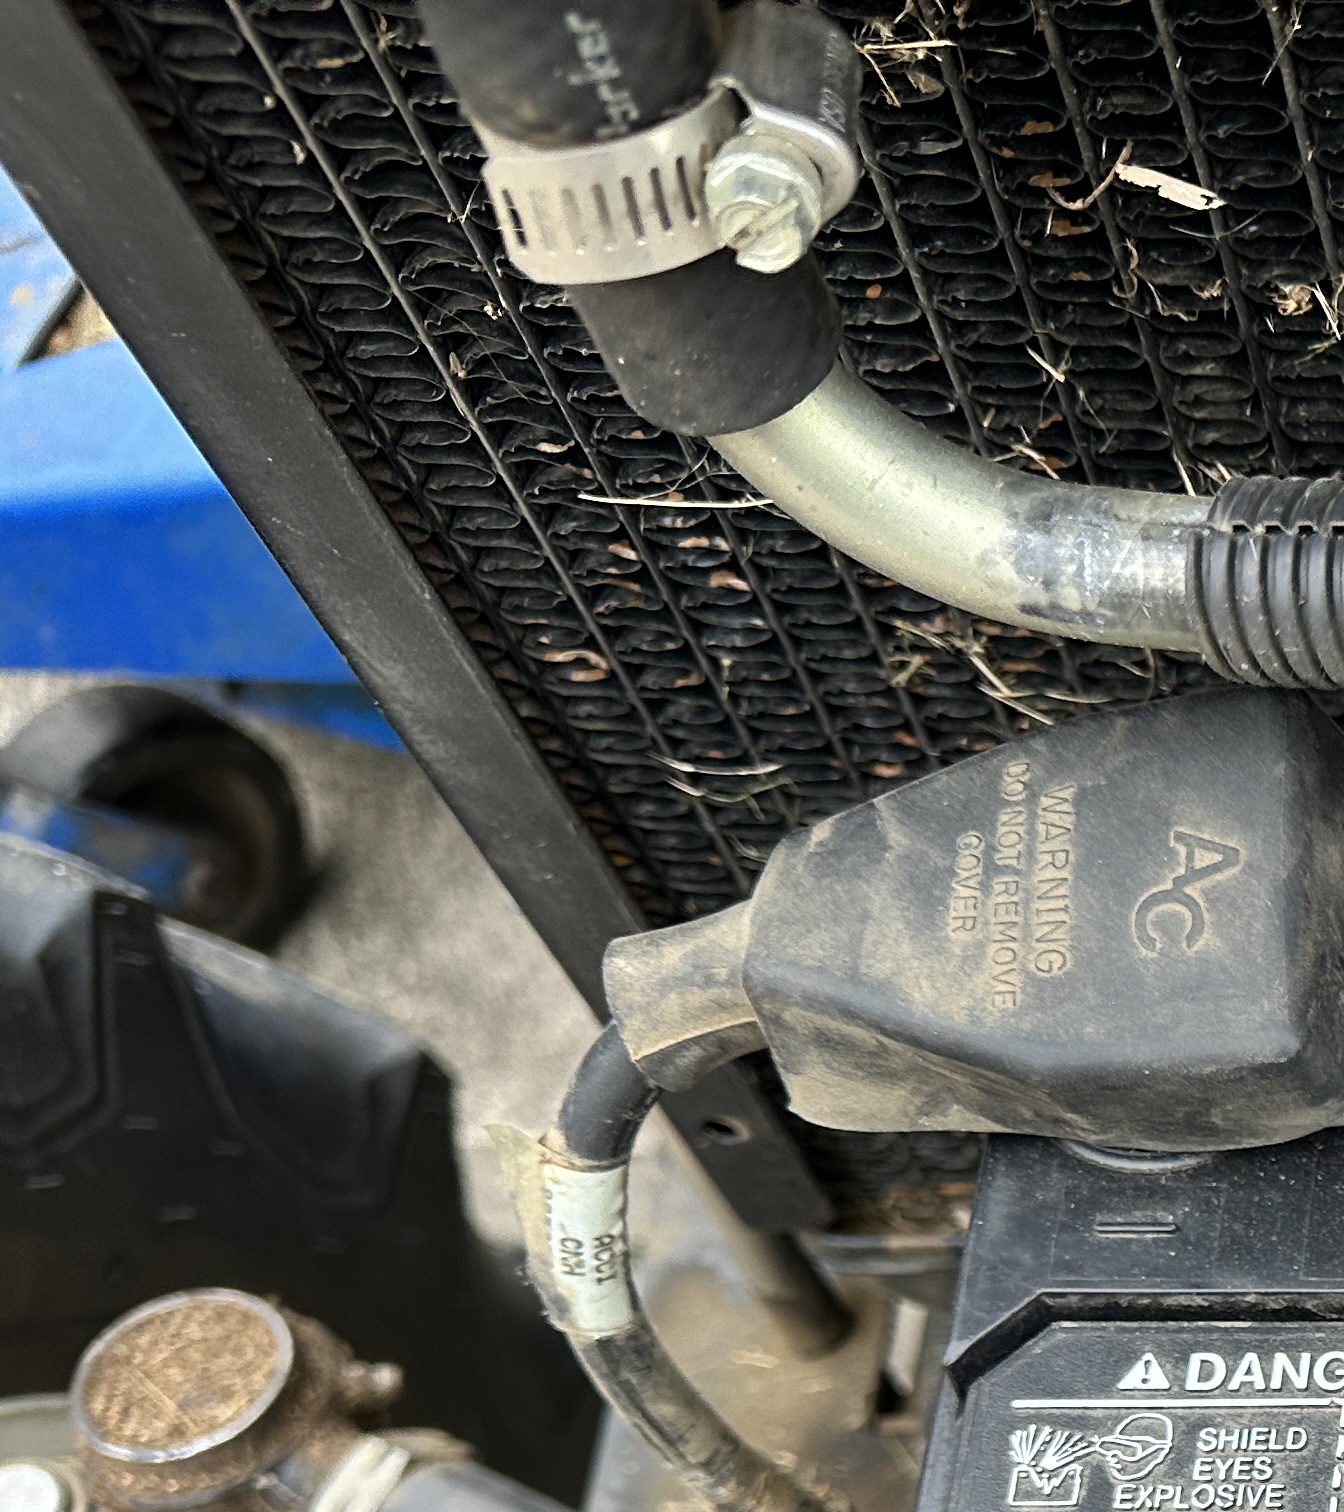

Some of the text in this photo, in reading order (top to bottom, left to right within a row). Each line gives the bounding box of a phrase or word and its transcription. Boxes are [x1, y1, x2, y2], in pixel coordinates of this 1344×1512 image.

[950, 834, 983, 932] COVER
[991, 762, 1031, 1008] DO NOT REMOVE
[1035, 784, 1077, 974] WARNING
[1192, 1456, 1273, 1482] EYES
[1197, 1426, 1308, 1452] SHIELD
[1113, 1484, 1285, 1510] EXPLOSIVE
